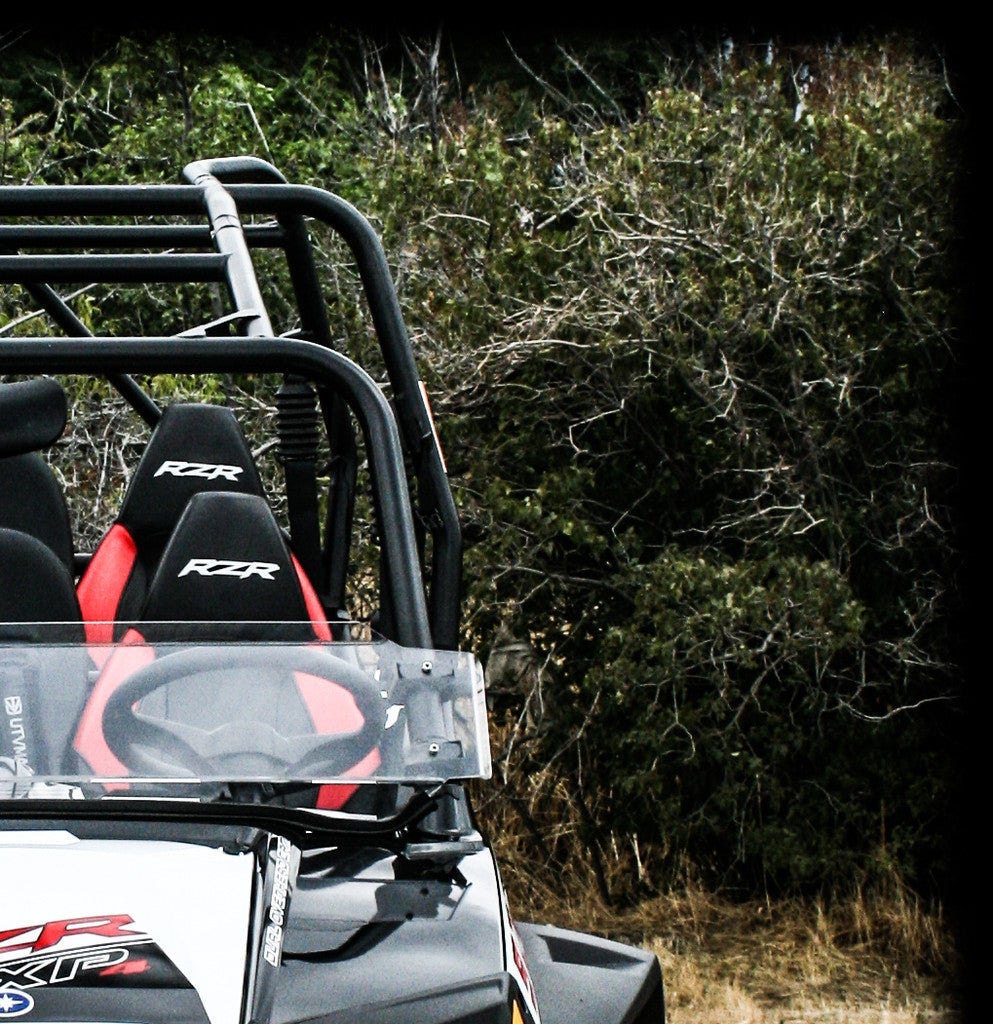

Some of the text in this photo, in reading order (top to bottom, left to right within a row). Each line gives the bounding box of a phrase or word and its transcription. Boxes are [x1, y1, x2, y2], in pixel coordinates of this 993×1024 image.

[153, 460, 244, 482] RZR
[177, 558, 281, 581] RZR
[263, 924, 283, 967] DUAL
